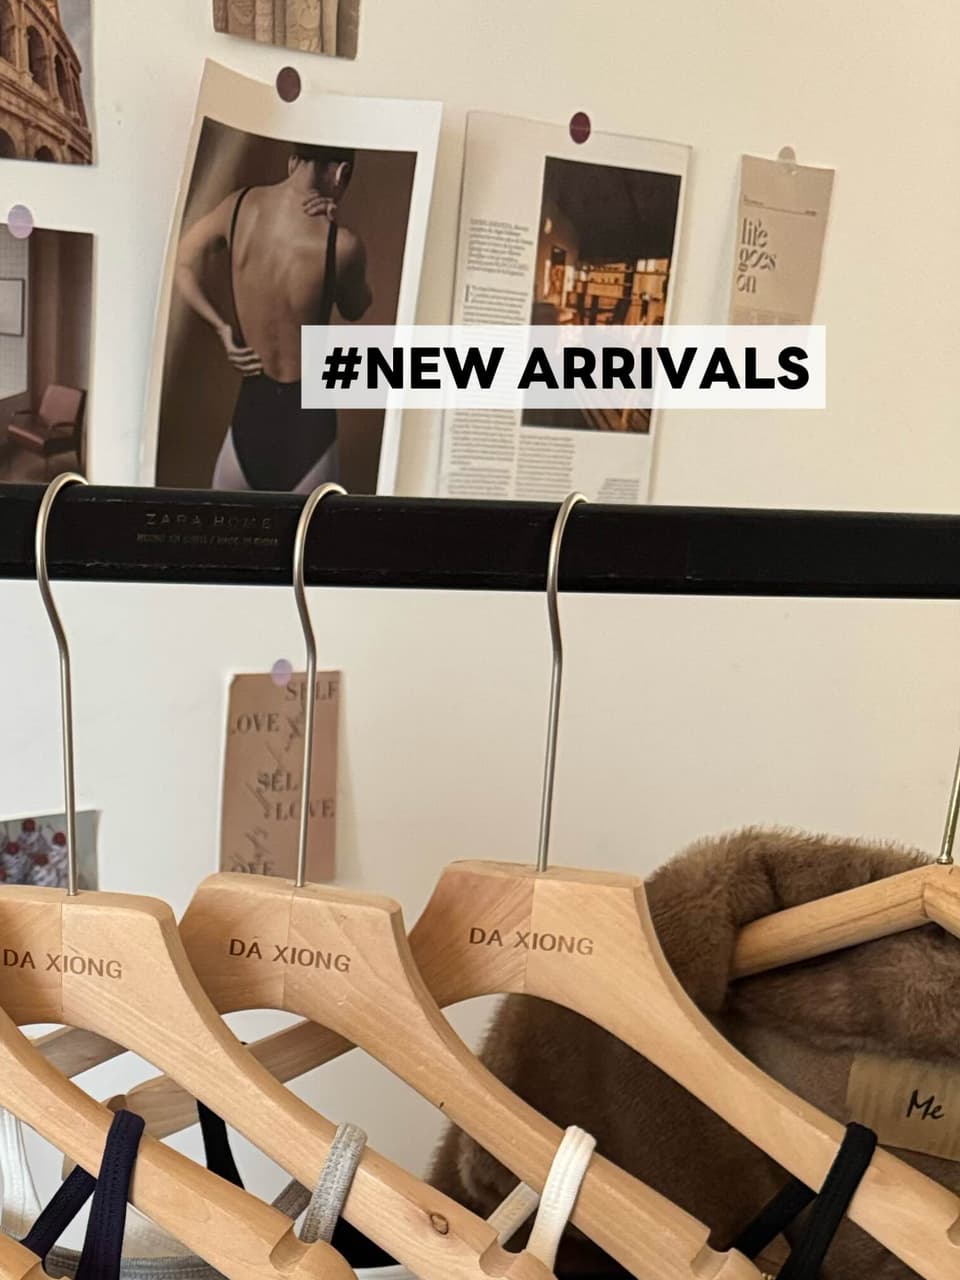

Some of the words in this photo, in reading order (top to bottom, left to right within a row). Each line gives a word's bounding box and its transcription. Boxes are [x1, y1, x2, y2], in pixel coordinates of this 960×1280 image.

[285, 680, 339, 702] SLF
[231, 712, 280, 736] OVE
[229, 938, 262, 960] DA
[272, 945, 351, 973] XIONG
[469, 927, 503, 947] DA
[514, 931, 594, 955] XIONG
[2, 948, 36, 969] DA
[45, 953, 123, 980] XIONG
[906, 1088, 945, 1120] Me
